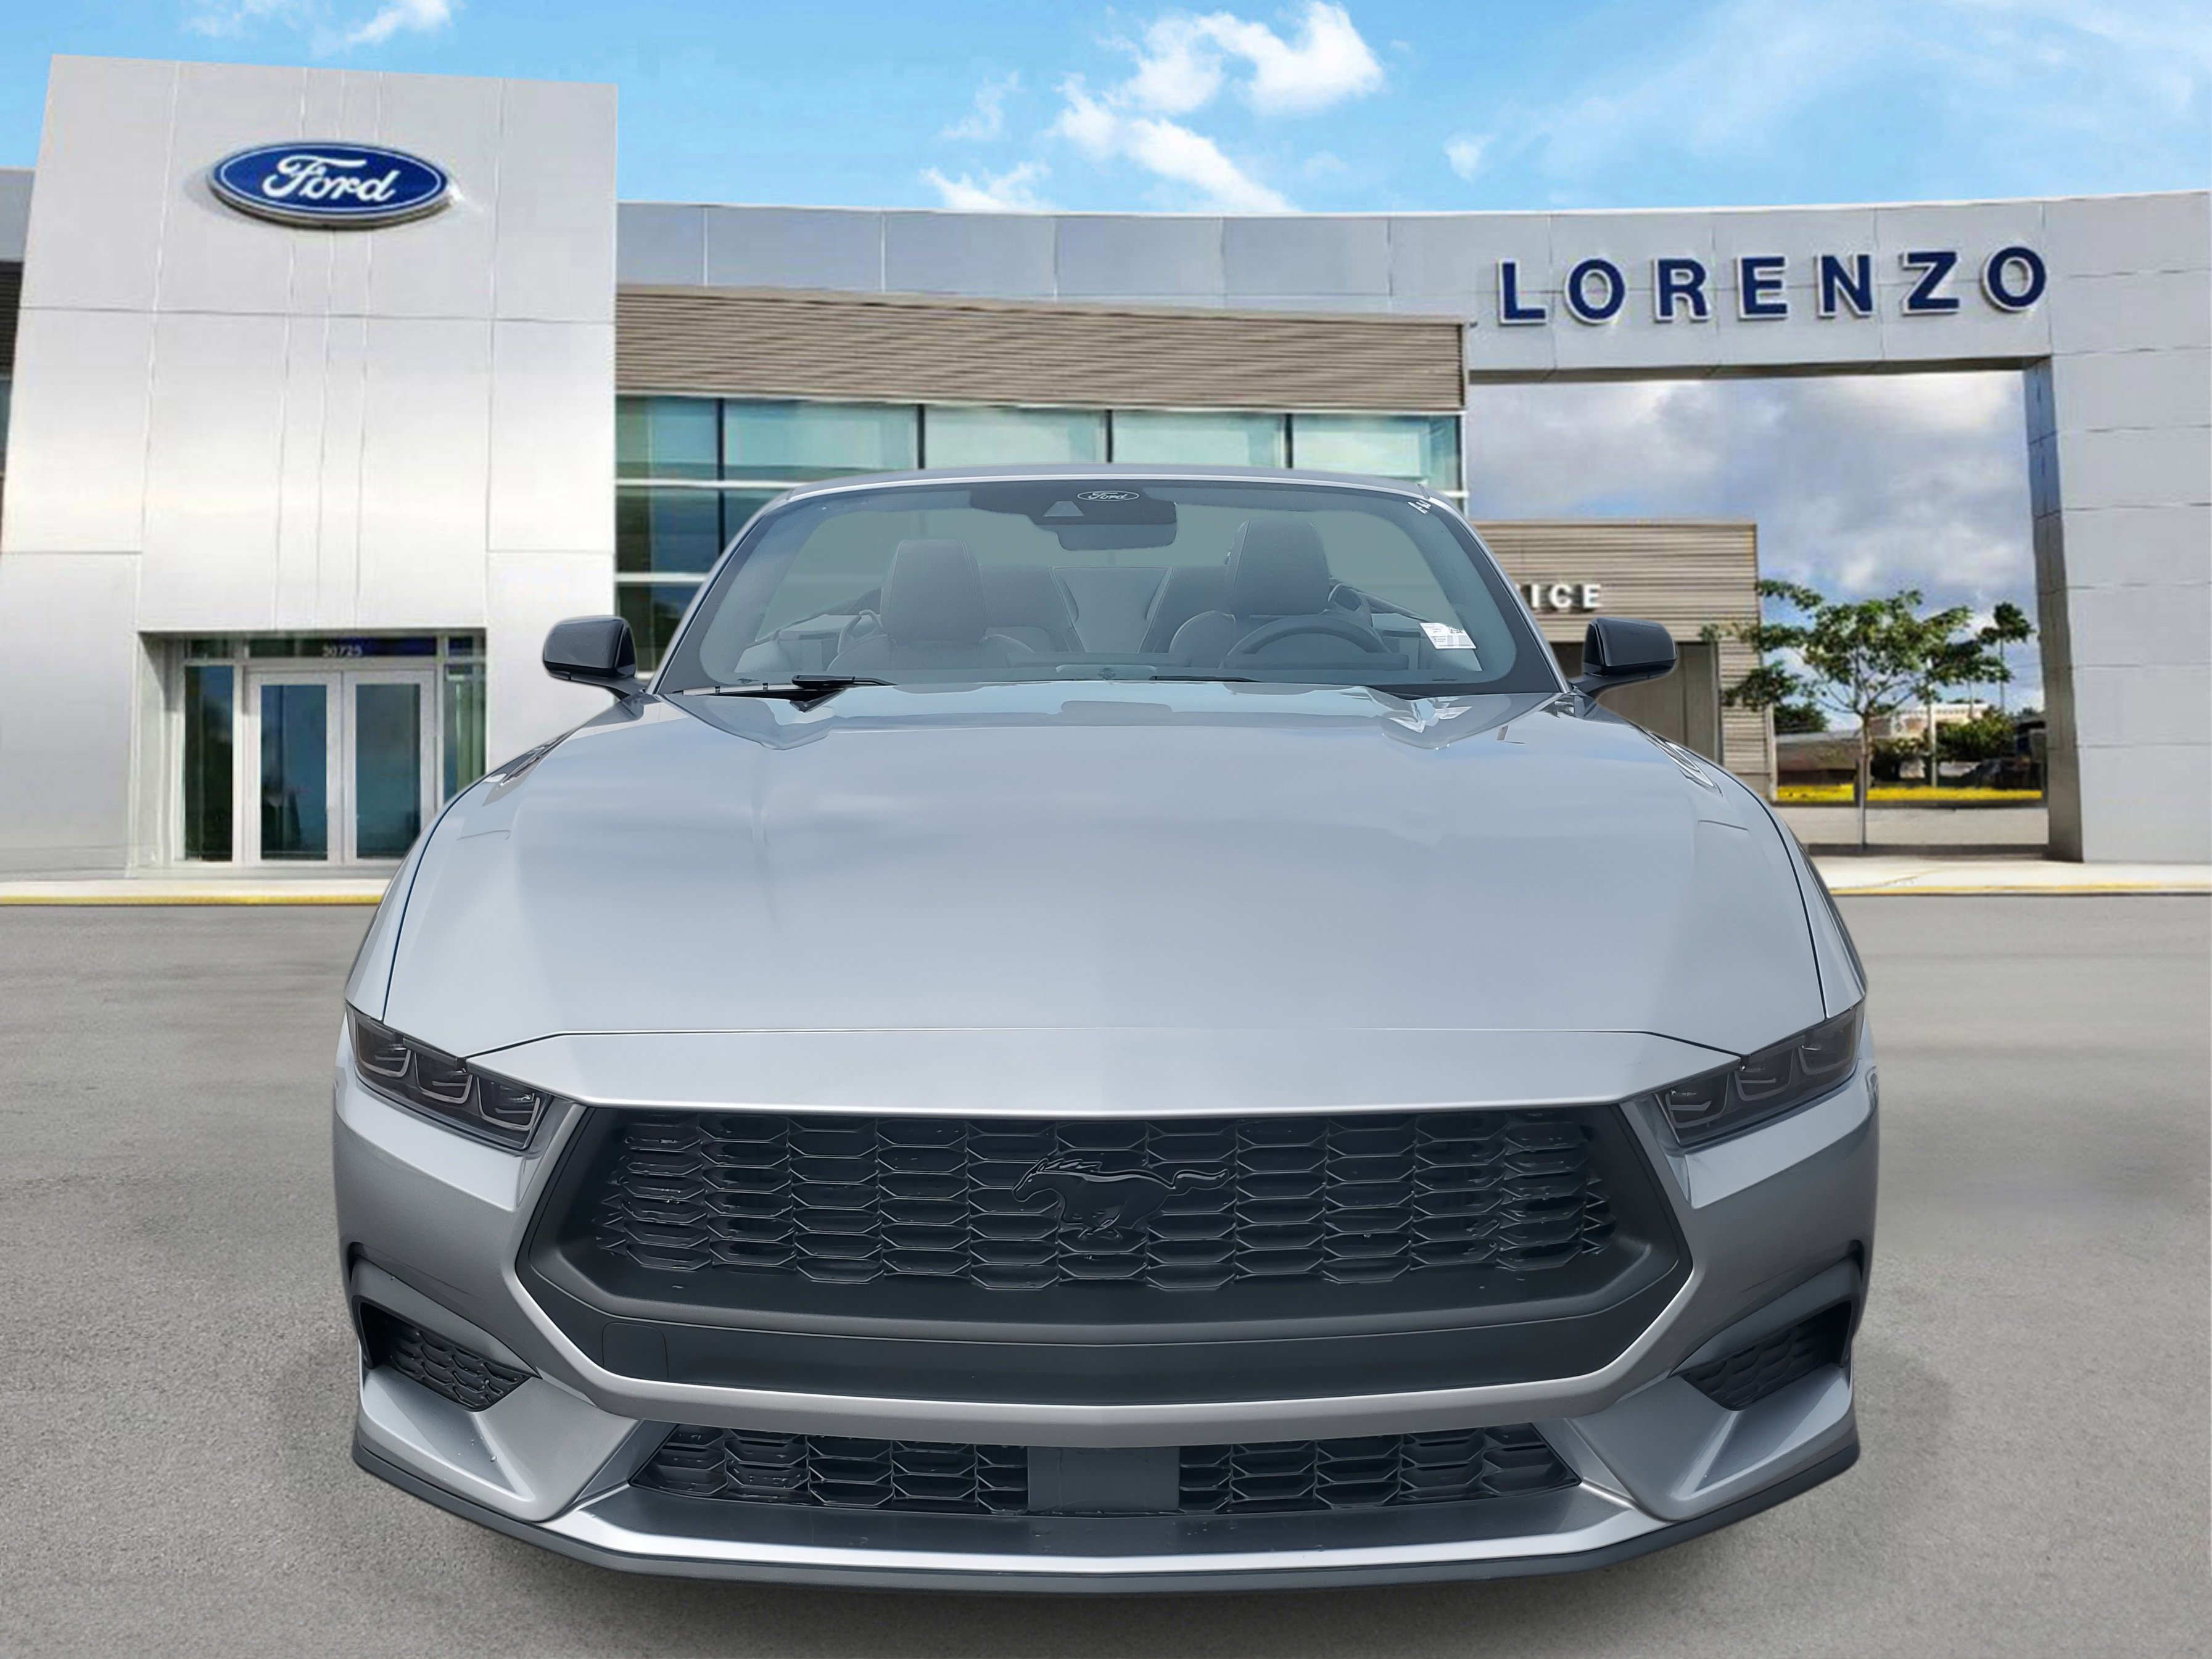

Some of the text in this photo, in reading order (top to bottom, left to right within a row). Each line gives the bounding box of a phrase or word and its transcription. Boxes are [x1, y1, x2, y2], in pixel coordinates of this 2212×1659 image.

[262, 154, 401, 202] Ford
[1499, 246, 2047, 325] LORENZO
[1087, 492, 1128, 500] Ford
[1516, 583, 1602, 609] ICE
